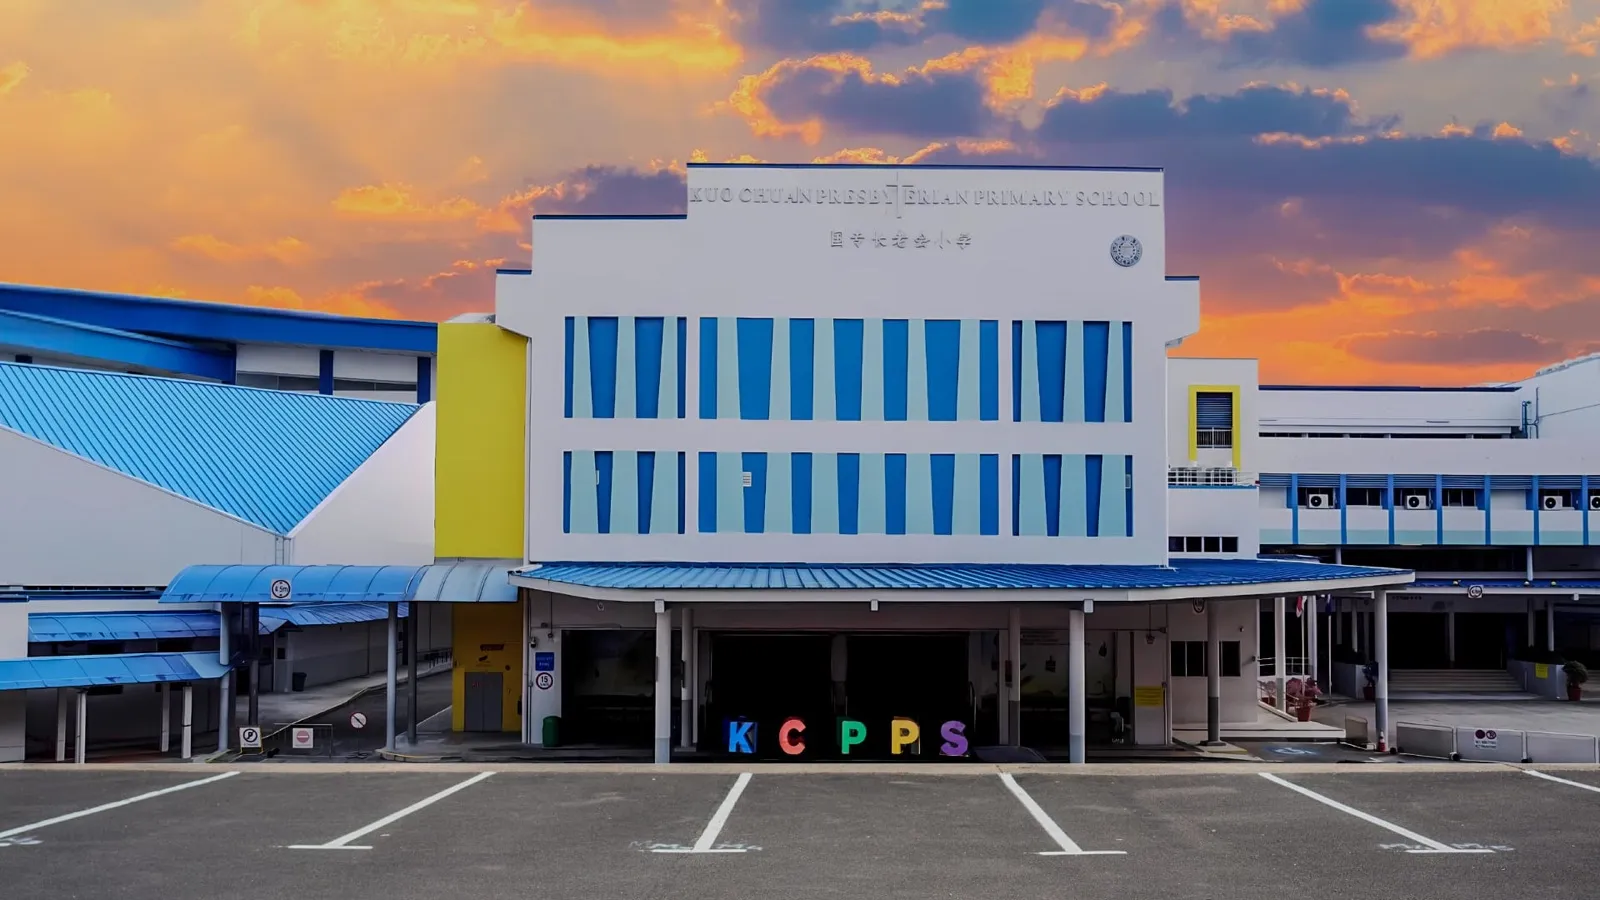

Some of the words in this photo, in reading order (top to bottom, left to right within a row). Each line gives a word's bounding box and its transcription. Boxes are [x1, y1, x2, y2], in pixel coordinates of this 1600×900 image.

[689, 187, 733, 203] KUO
[738, 187, 812, 204] CHUAN
[973, 189, 1071, 206] PRIMARY
[1075, 190, 1160, 207] SCHOOL
[541, 675, 548, 683] 15
